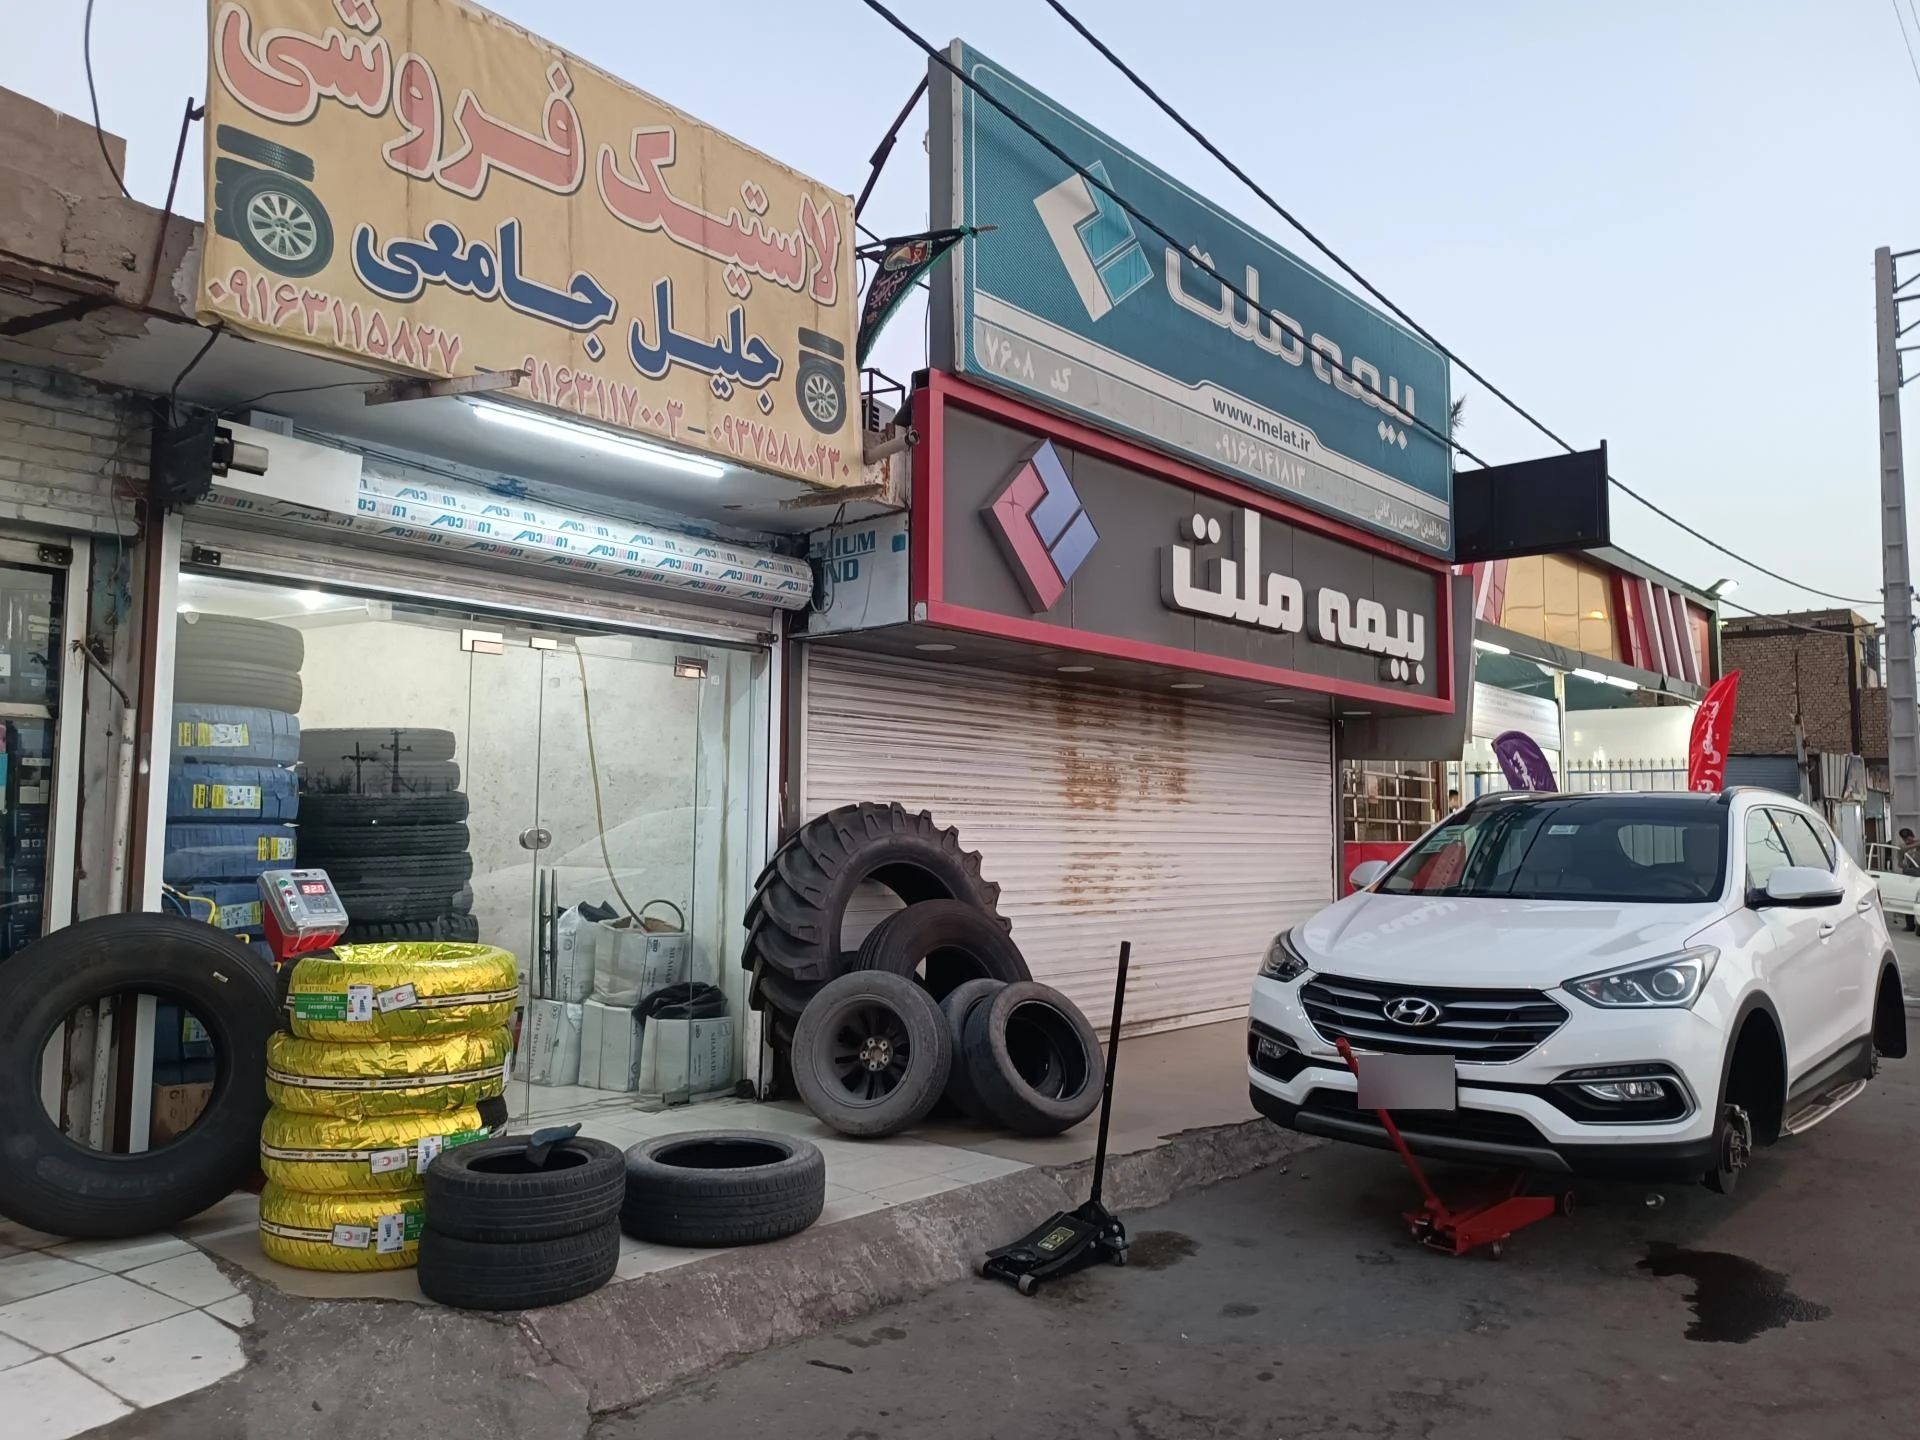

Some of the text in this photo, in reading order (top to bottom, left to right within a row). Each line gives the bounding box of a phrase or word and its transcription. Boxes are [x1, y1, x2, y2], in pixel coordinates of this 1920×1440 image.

[214, 0, 842, 305] لاستیک فروشی
[208, 269, 461, 375] ۰۹۱۶۳۱۱۵۸۲۷
[352, 217, 783, 411] جلیل جامعی
[985, 332, 1072, 393] کد ۷۶۰۸
[1166, 245, 1415, 449] بیمه ملت
[523, 356, 685, 440] ۹۱۶۳۱۱۷۰۰۳
[1212, 397, 1311, 452] www.melat.ir
[1163, 508, 1425, 685] بیمه ملت
